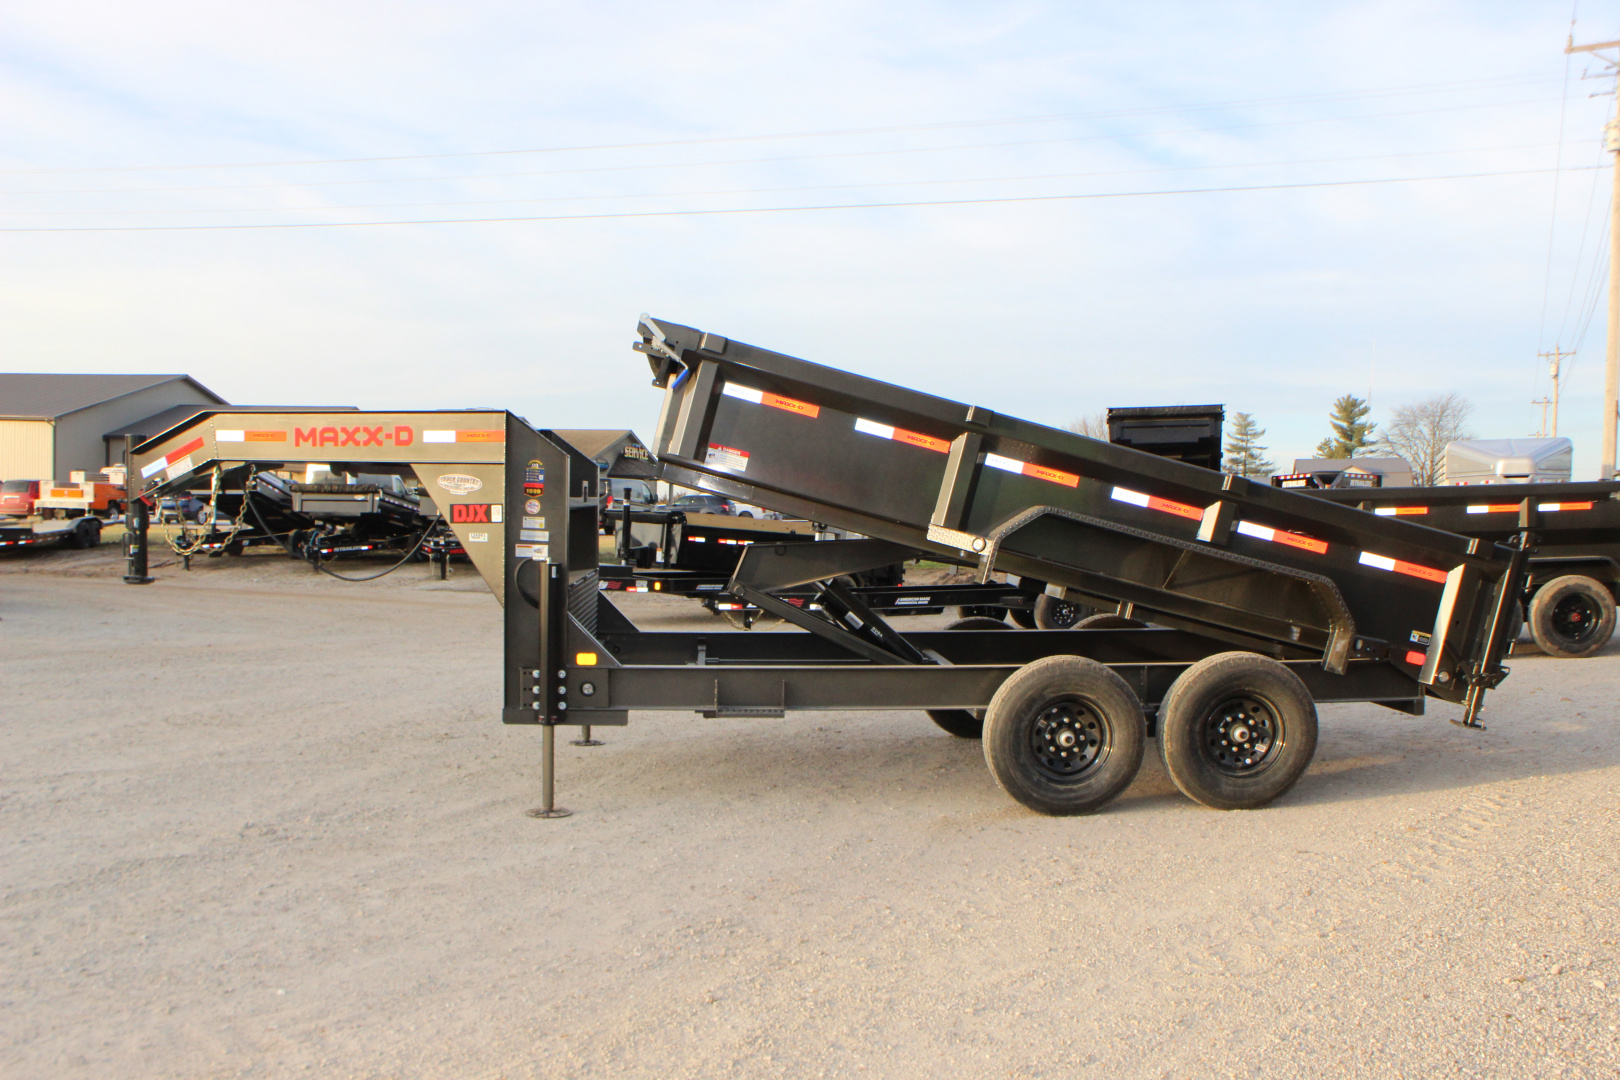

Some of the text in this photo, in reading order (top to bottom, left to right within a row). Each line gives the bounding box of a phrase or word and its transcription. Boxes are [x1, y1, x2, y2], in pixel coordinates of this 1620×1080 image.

[775, 399, 804, 411] MAXX-D
[294, 426, 414, 447] MAXX-D
[907, 434, 935, 446] MAXX-D
[624, 446, 649, 460] SERVICE
[722, 446, 741, 456] DANGER
[1036, 469, 1064, 480] MAXX-D
[456, 476, 480, 486] COUNTRY
[453, 504, 488, 523] DJX
[1162, 502, 1189, 514] MAXX-D
[1287, 536, 1313, 548] MAXX-D
[1407, 566, 1433, 577] MAXX-D
